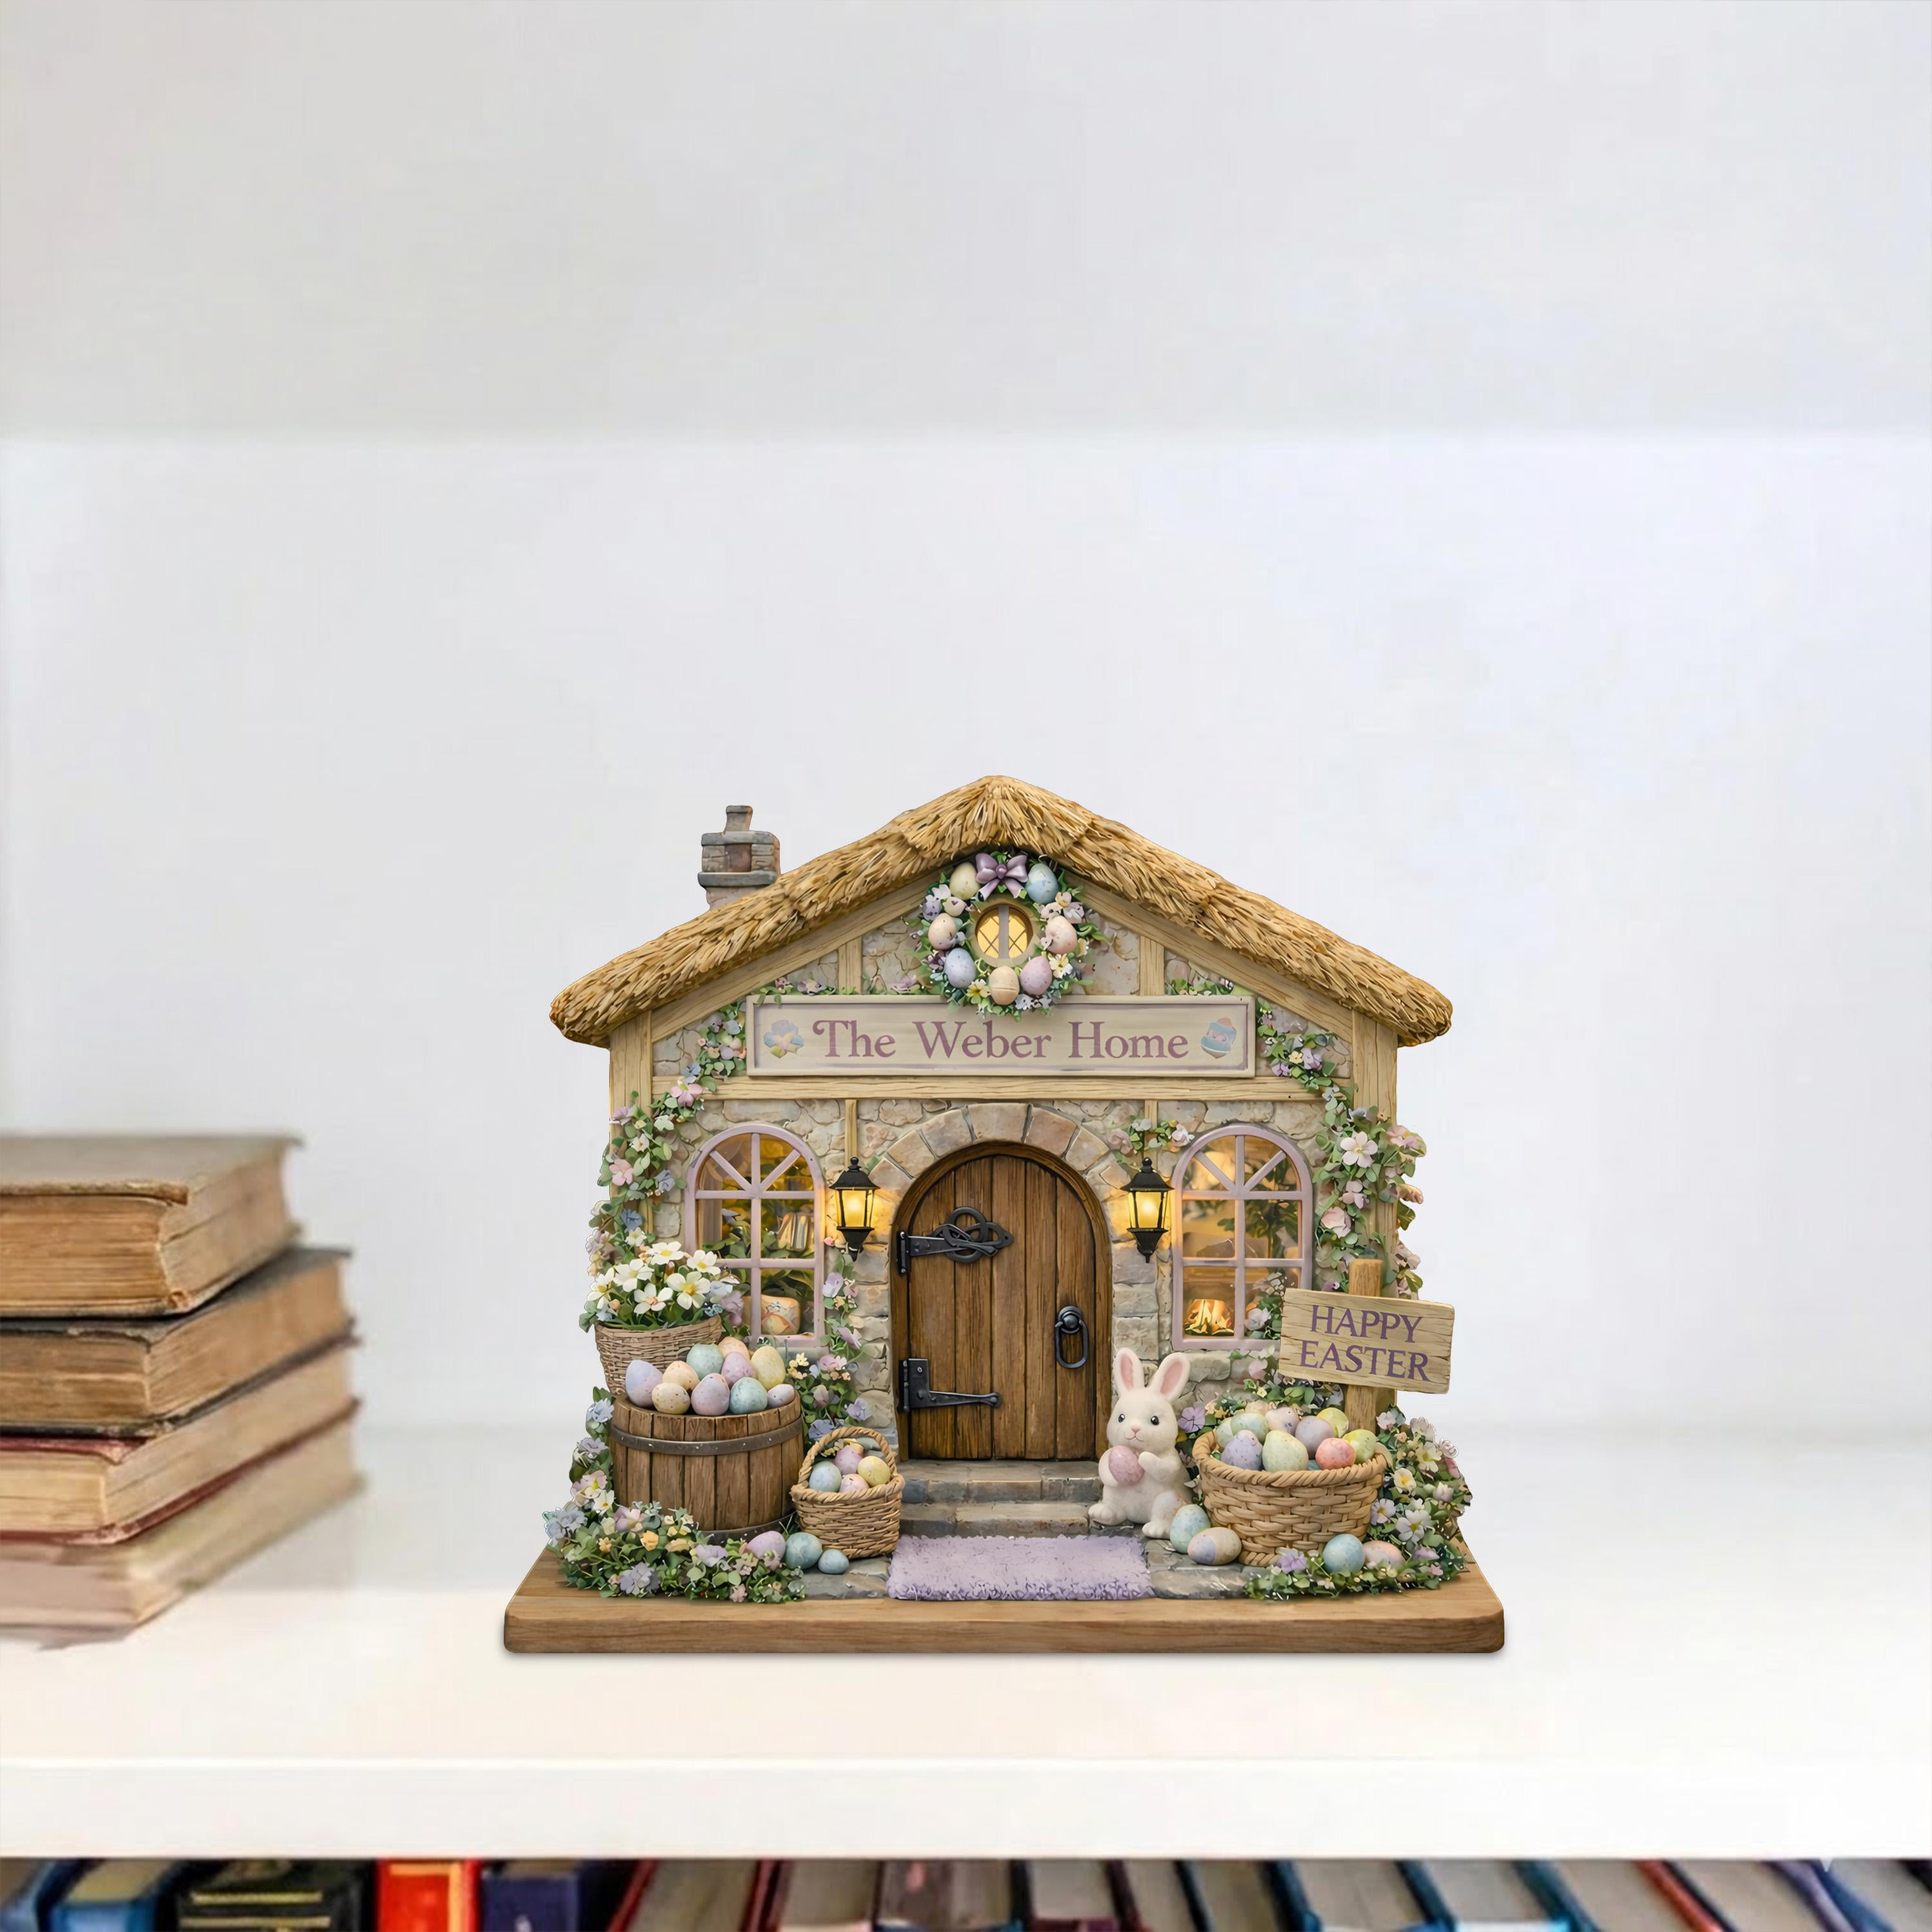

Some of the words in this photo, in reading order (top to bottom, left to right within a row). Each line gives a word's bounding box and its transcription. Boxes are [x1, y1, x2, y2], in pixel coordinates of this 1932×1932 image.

[812, 1019, 896, 1058] The
[911, 1020, 1052, 1059] Weber
[1067, 1020, 1189, 1059] Home
[1310, 1304, 1424, 1343] HAPPY
[1298, 1340, 1431, 1382] EASTER
